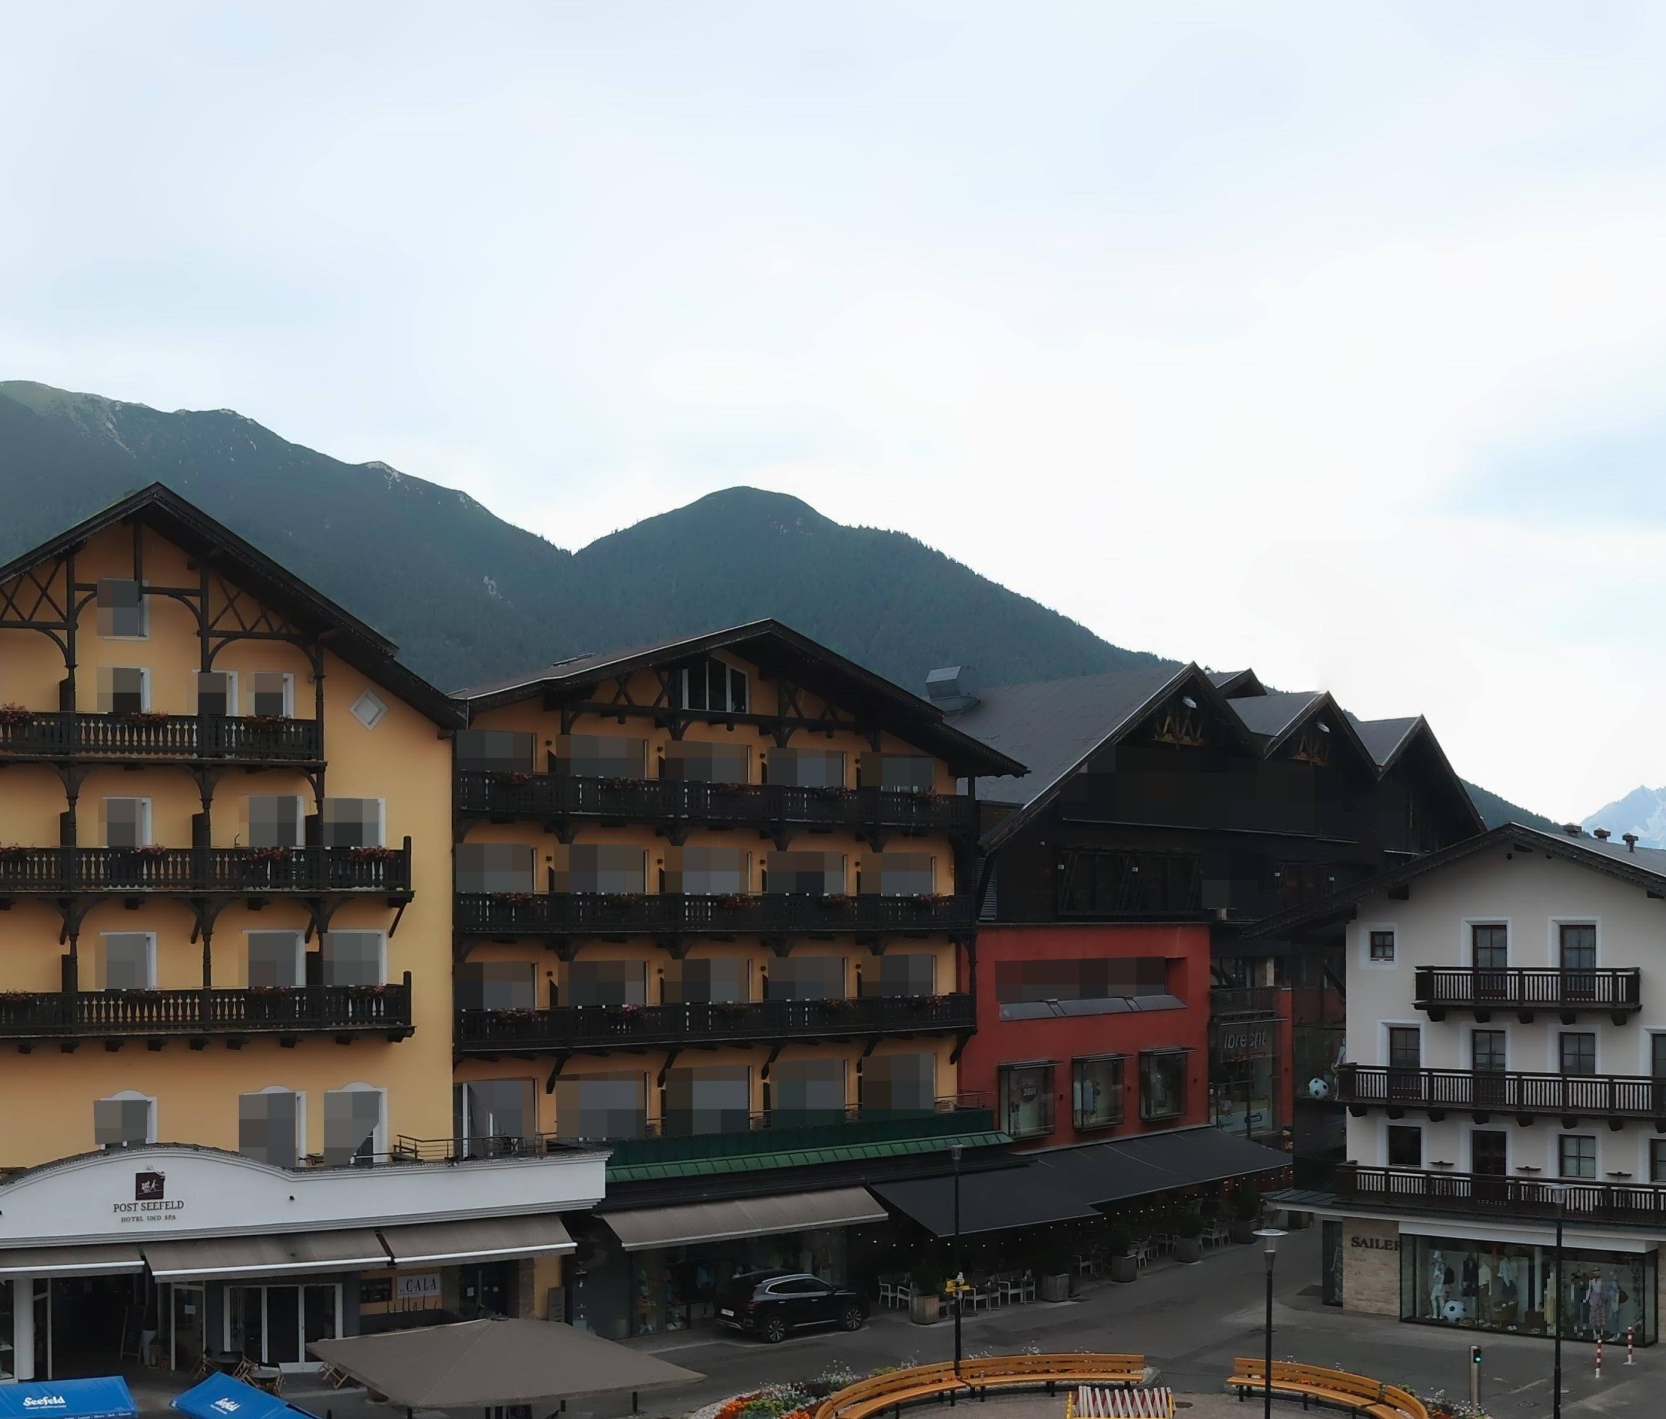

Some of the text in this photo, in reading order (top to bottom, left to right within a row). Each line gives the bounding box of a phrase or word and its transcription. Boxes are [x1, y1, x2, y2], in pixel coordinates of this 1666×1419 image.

[113, 1200, 185, 1213] POST SEEFELD
[22, 1395, 66, 1407] Seefeld
